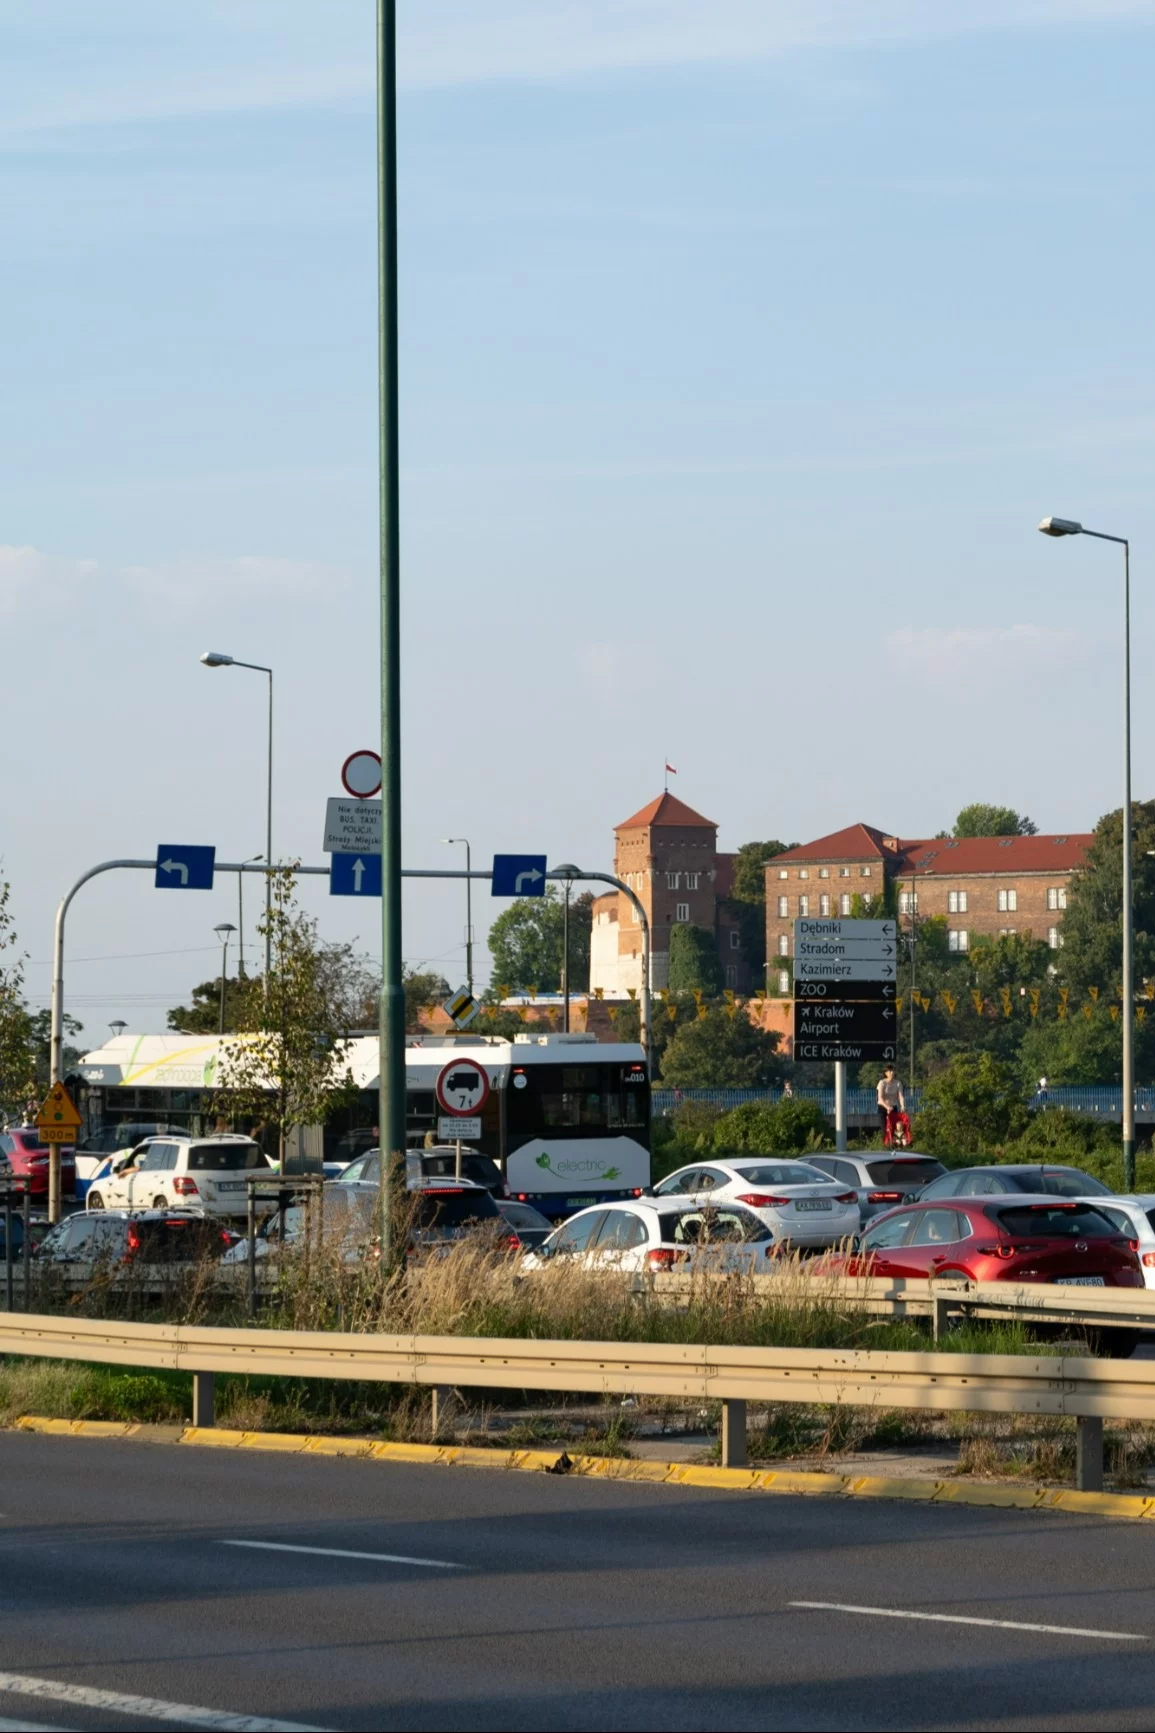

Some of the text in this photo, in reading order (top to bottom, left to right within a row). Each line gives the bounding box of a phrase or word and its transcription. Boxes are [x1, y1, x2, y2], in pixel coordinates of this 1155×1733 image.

[338, 805, 351, 813] Nie
[800, 922, 842, 936] Dębniki
[800, 942, 846, 955] Stradom
[800, 963, 852, 976] Kazimierz
[800, 983, 827, 996] ZOO
[814, 1006, 854, 1019] Kraków
[800, 1022, 840, 1036] Airport
[800, 1045, 862, 1058] ICE Kraków
[557, 1158, 608, 1173] electric
